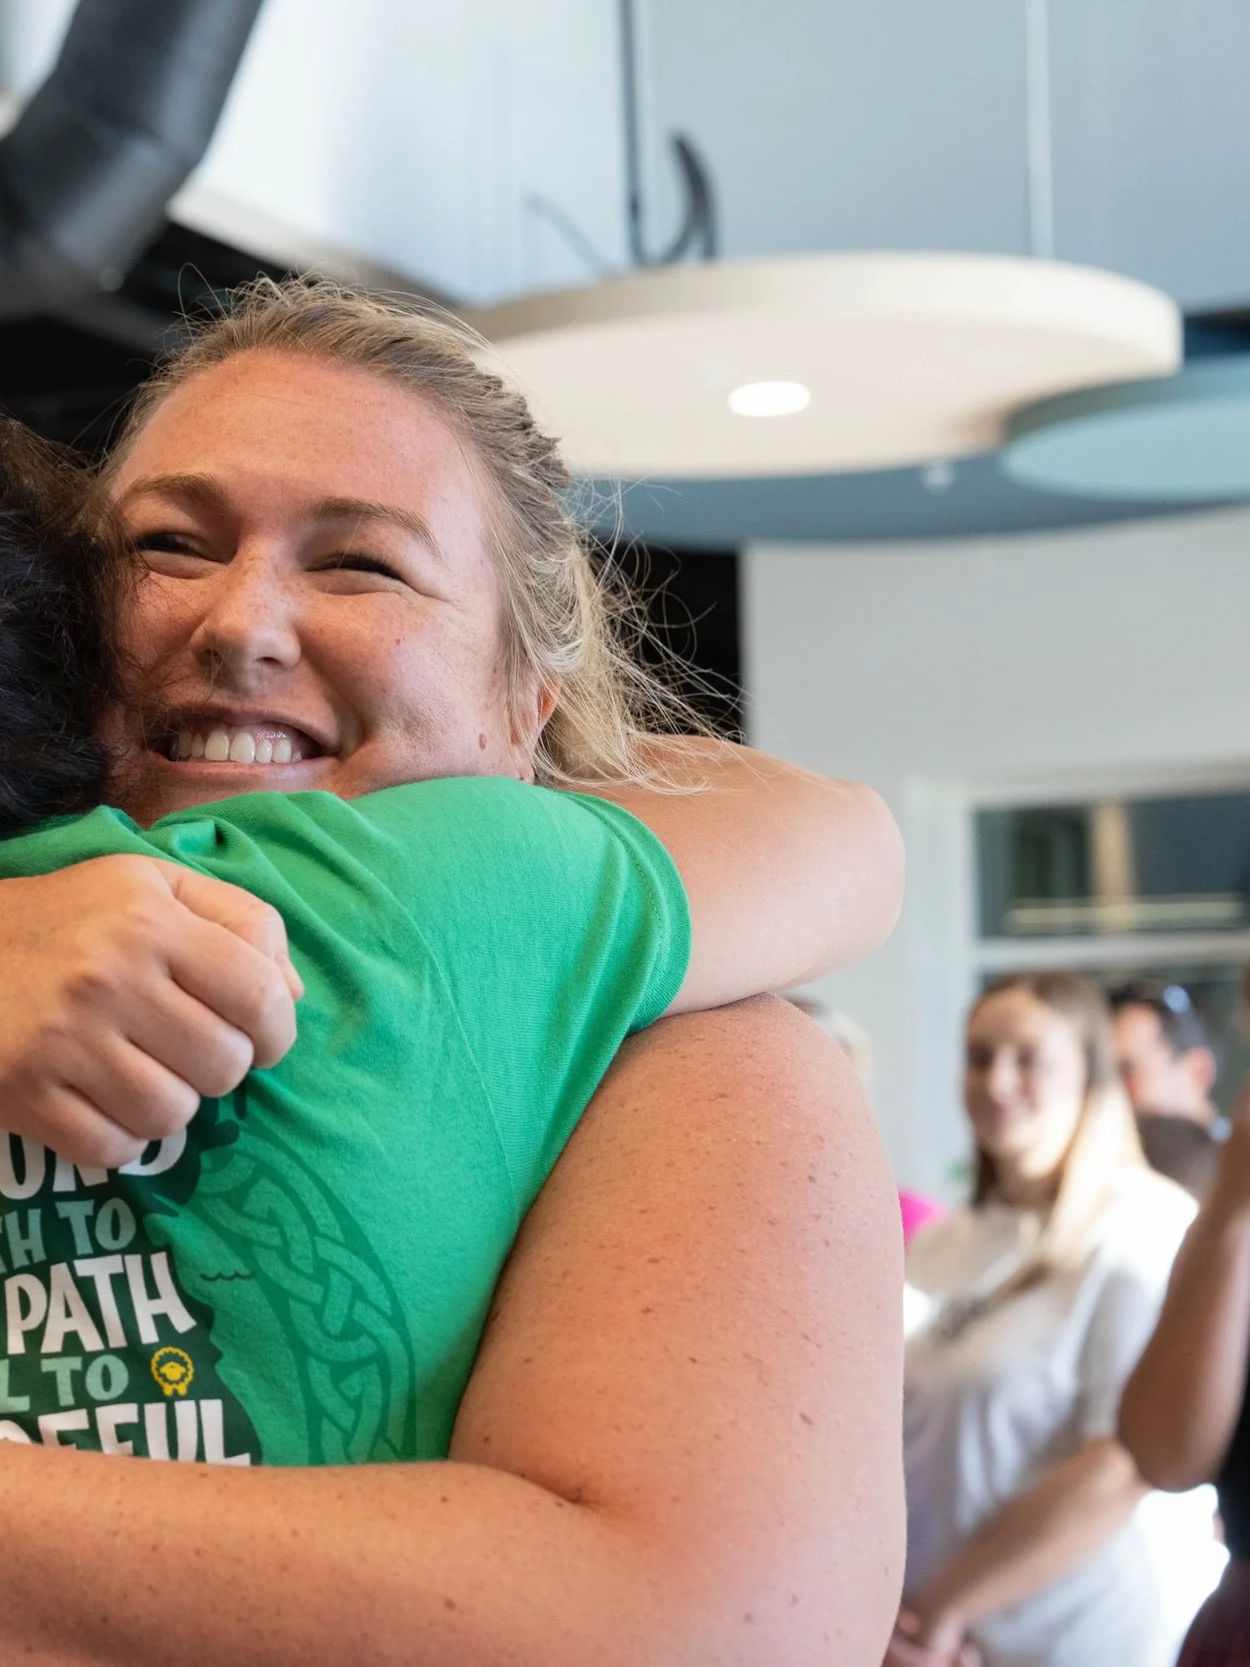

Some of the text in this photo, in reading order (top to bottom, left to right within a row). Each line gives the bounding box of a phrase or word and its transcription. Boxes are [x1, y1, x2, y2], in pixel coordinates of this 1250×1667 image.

[55, 1198, 137, 1258] TO
[6, 1253, 197, 1355] PATH
[40, 1354, 130, 1407] TO
